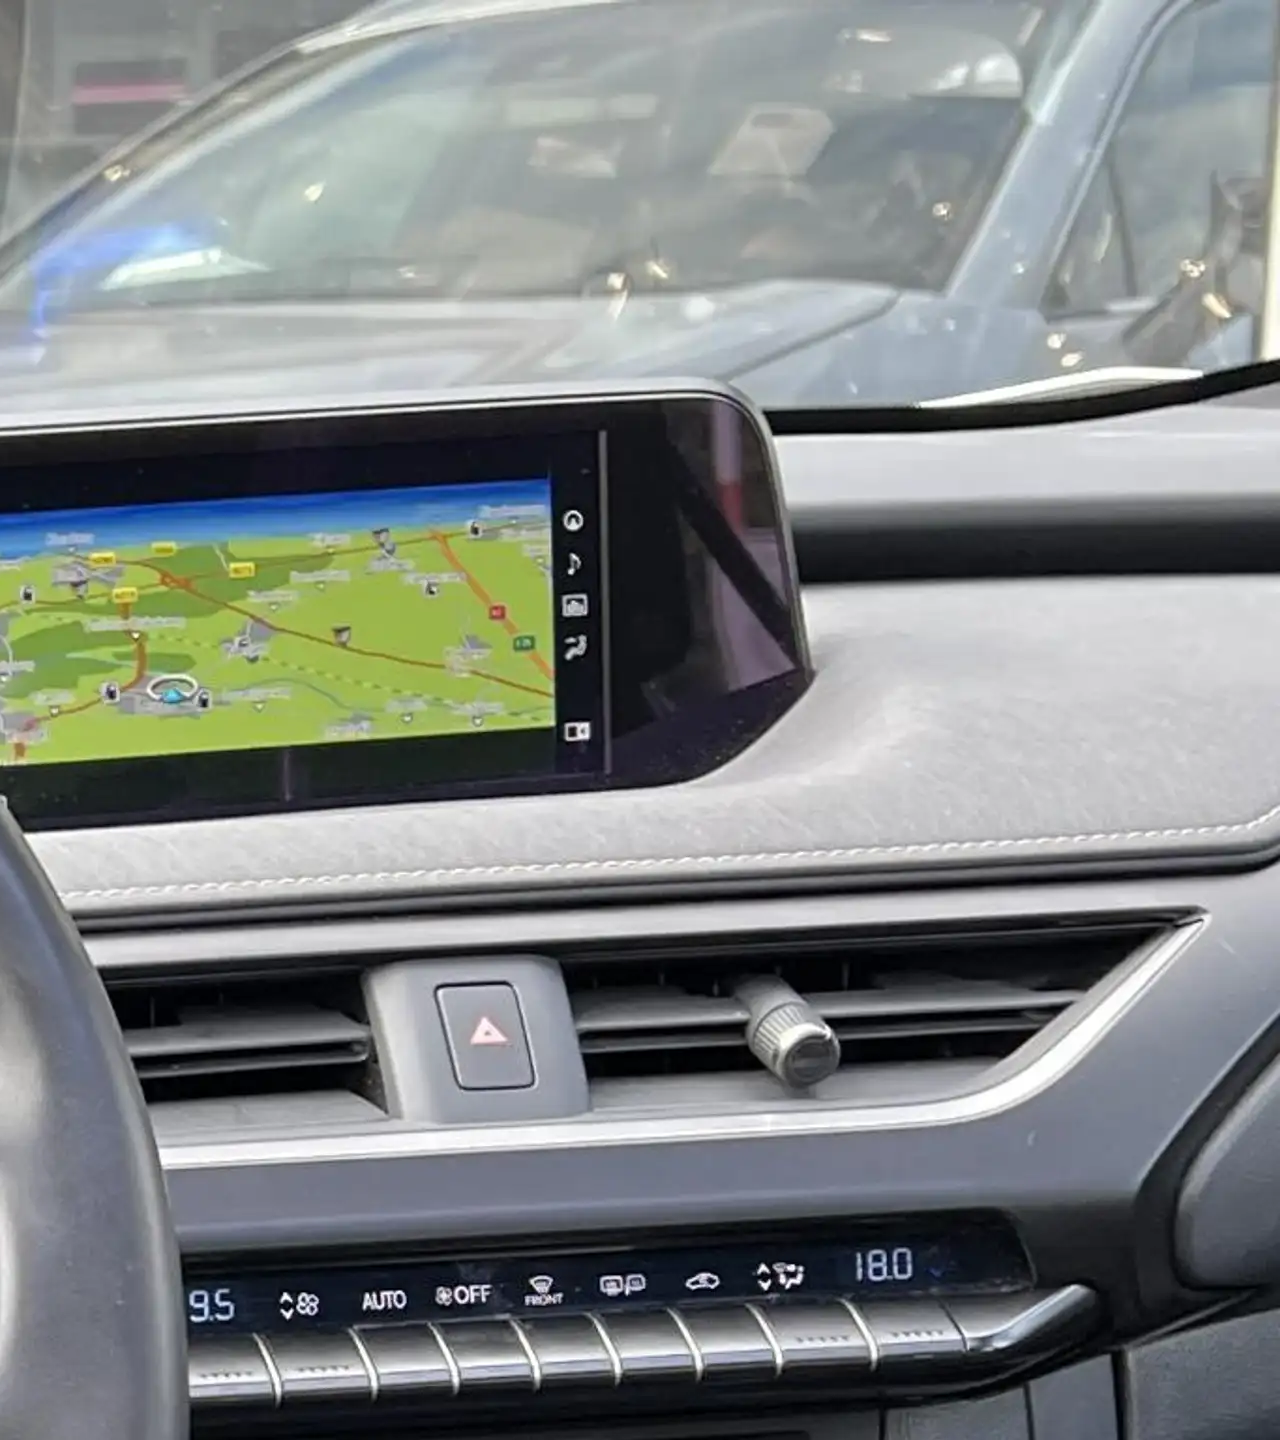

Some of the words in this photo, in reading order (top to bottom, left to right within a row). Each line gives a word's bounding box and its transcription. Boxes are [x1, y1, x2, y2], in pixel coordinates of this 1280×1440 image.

[855, 1248, 913, 1282] 18.0
[362, 1290, 408, 1311] AUTO
[457, 1284, 493, 1305] OFF
[524, 1292, 564, 1307] FRONT
